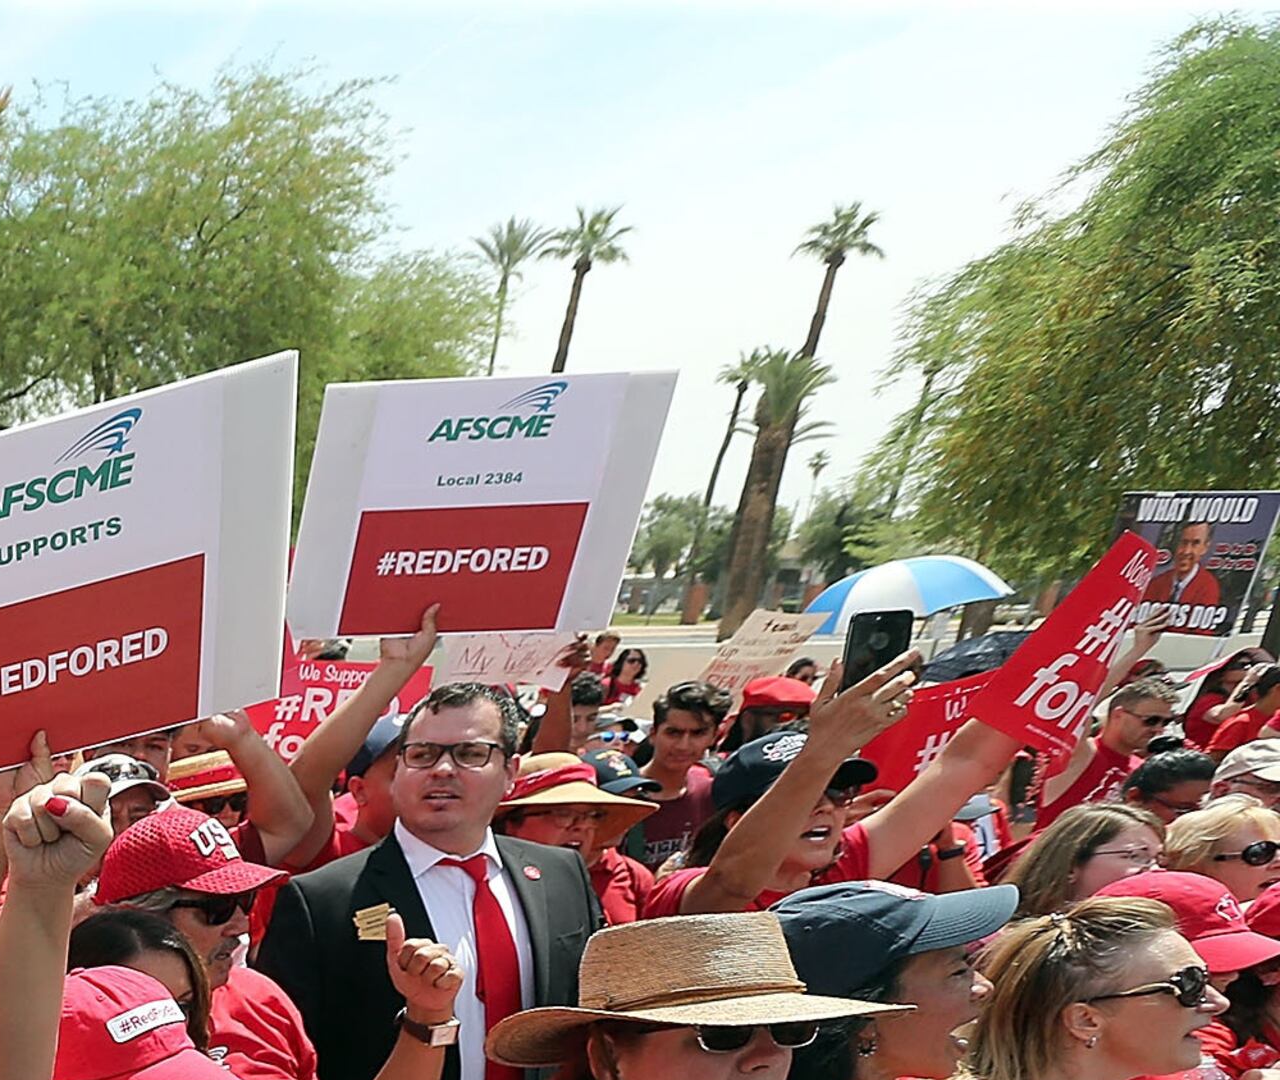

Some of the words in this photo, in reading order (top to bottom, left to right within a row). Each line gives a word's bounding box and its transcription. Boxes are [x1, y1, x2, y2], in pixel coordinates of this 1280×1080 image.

[427, 414, 556, 443] AFSCME
[437, 474, 479, 487] Local
[485, 471, 523, 485] 2384
[1136, 497, 1191, 523] WHAT
[1188, 497, 1259, 523] WOULD
[376, 546, 549, 576] #REDFORED
[1188, 605, 1227, 629] DO?
[299, 663, 324, 683] We
[324, 665, 370, 688] Suppo
